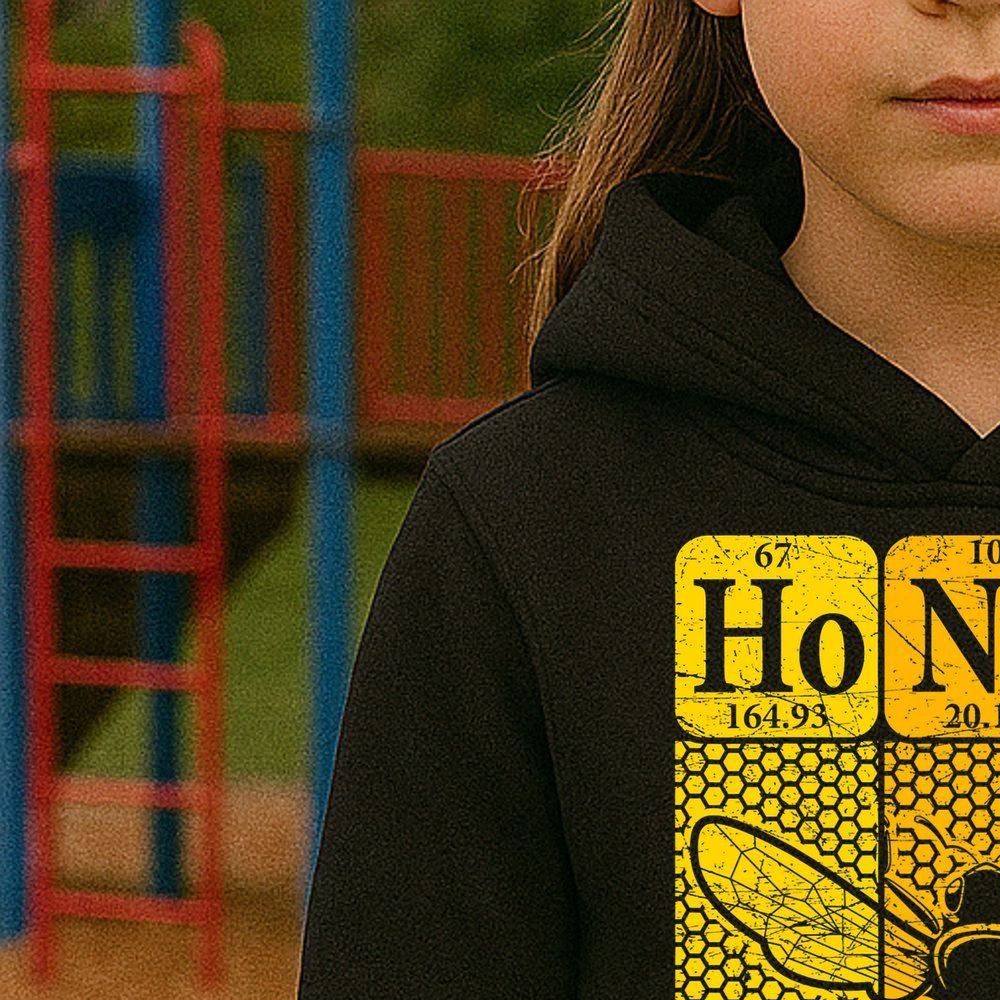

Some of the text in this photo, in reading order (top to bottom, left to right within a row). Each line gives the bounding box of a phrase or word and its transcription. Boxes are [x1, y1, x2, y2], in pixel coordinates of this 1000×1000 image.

[754, 541, 790, 569] 67
[694, 578, 865, 696] Ho
[727, 704, 827, 730] 164.93
